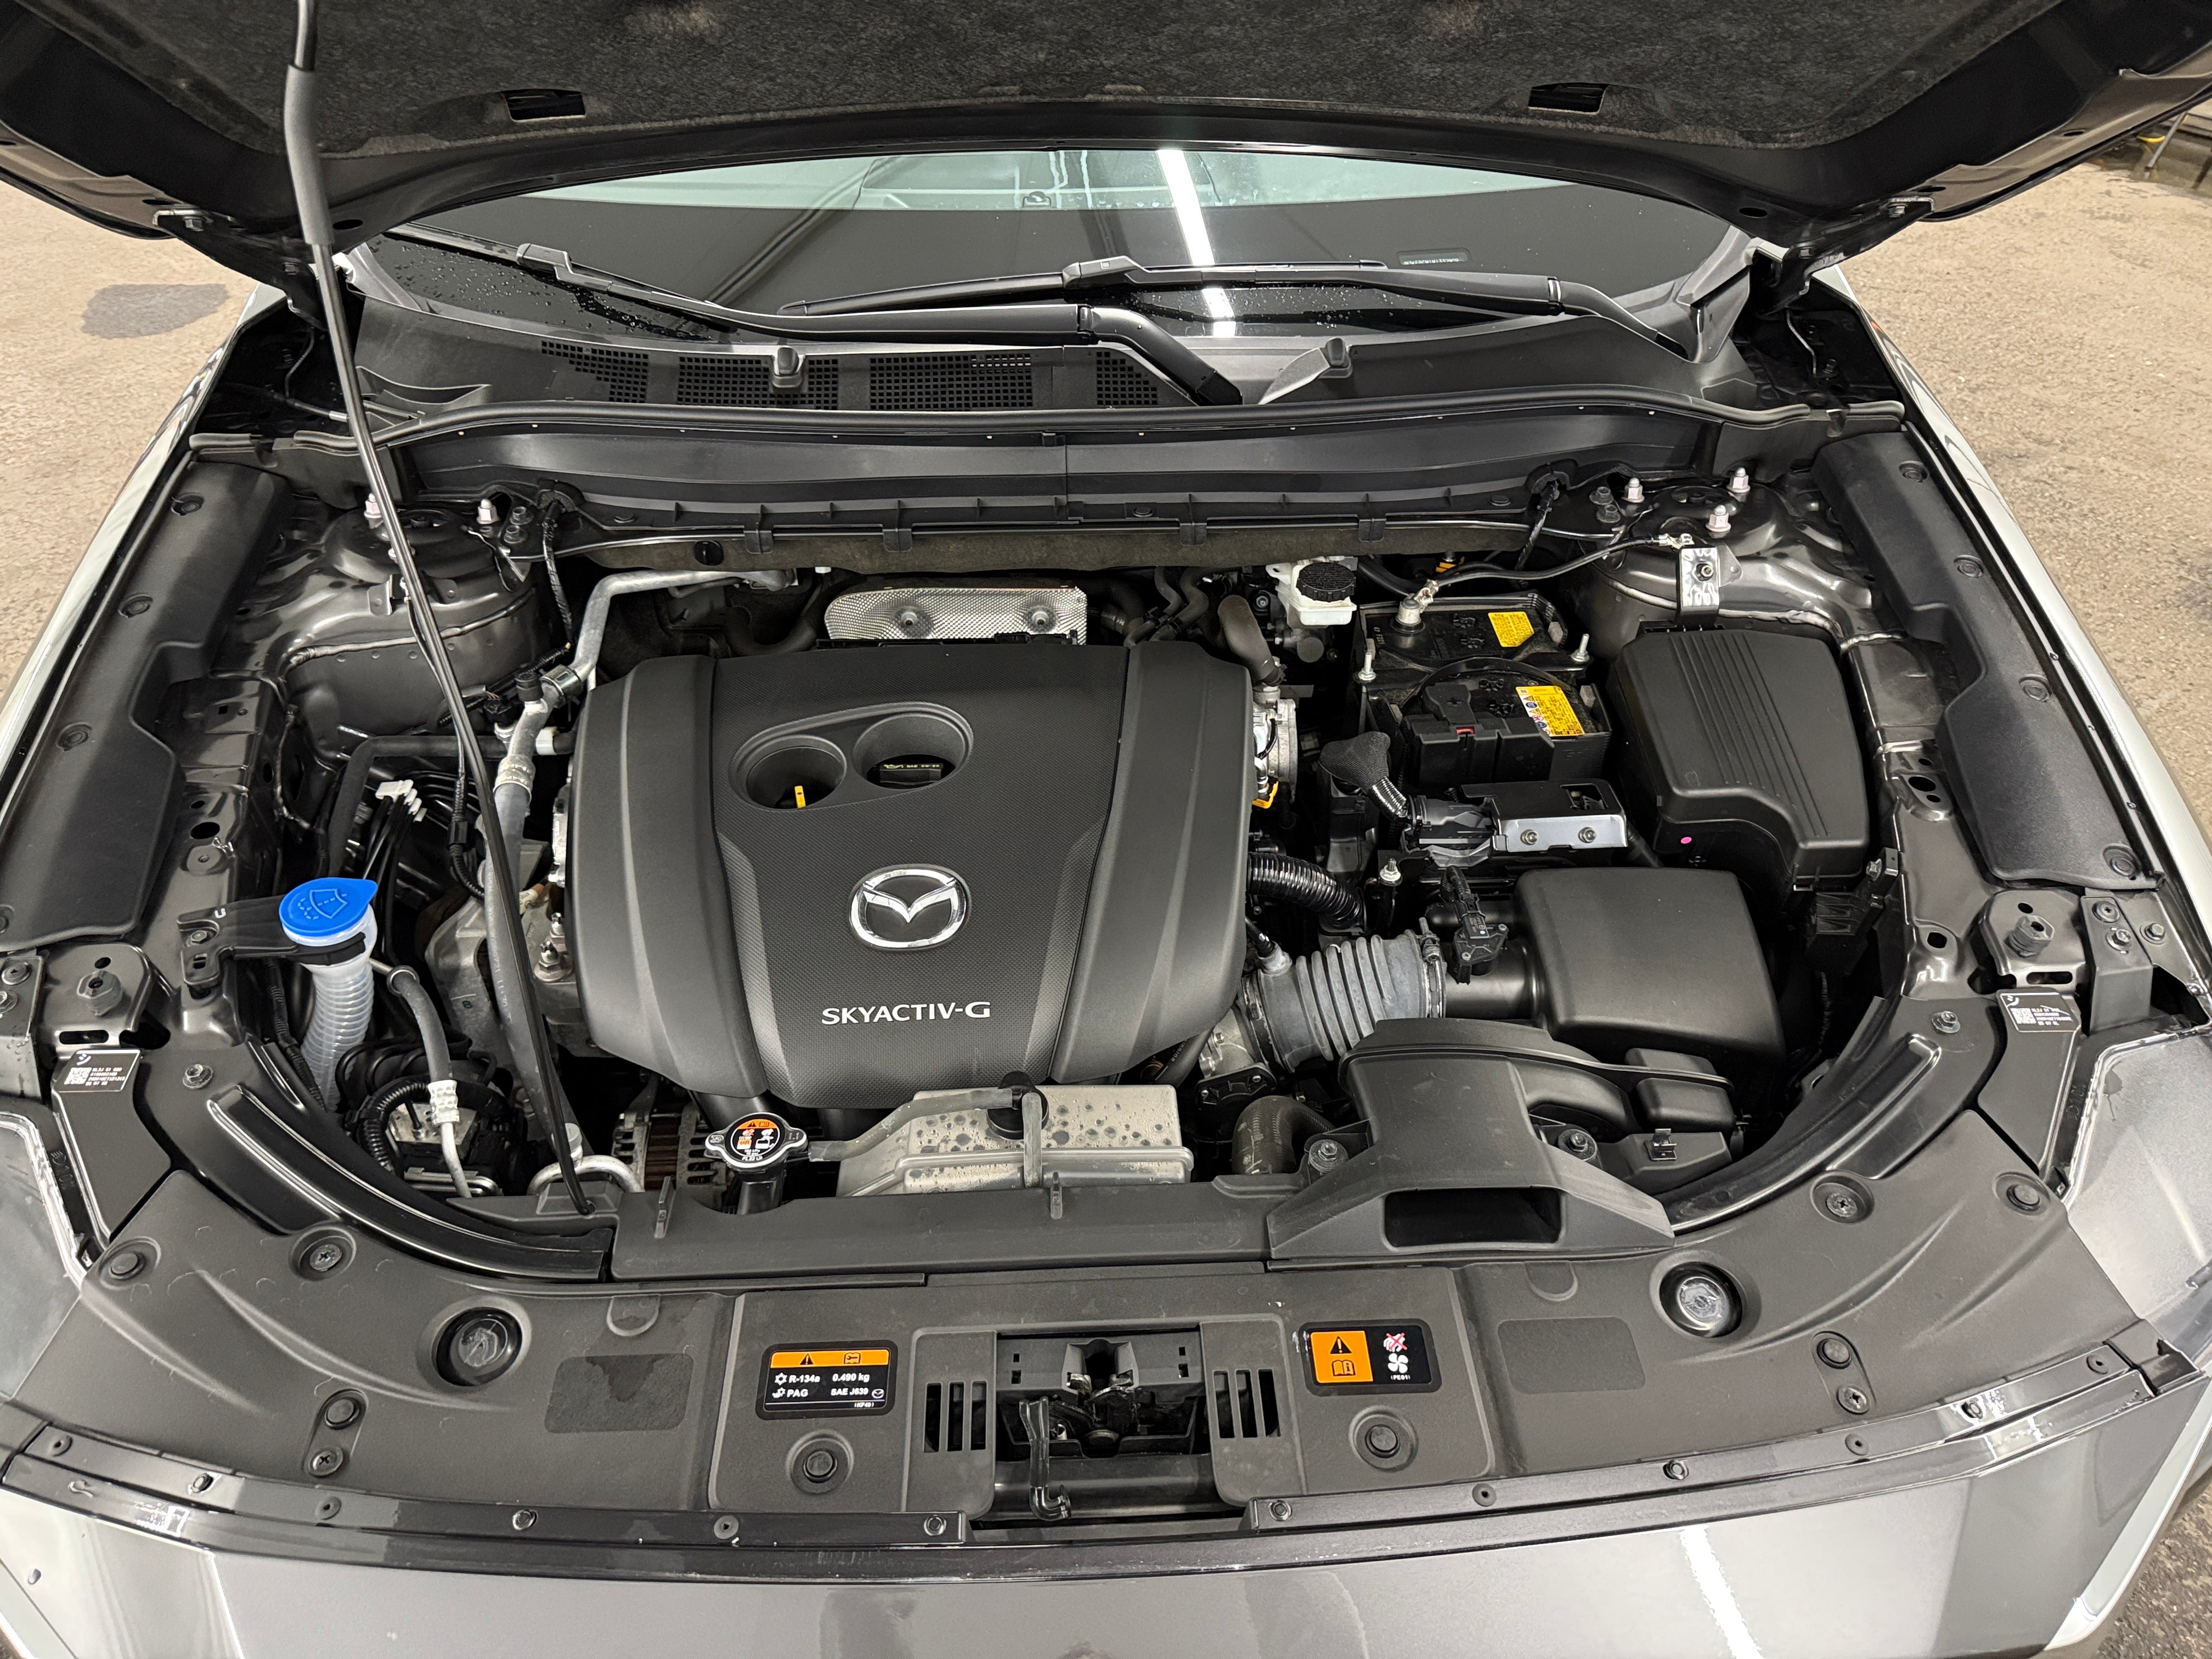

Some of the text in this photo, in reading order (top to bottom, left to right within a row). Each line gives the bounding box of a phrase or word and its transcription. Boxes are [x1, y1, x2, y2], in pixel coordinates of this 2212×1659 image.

[821, 1002, 991, 1025] SKYACTIV-G
[789, 1373, 870, 1383] R-134a 0.490 kg
[787, 1387, 869, 1397] PAG SAE J639
